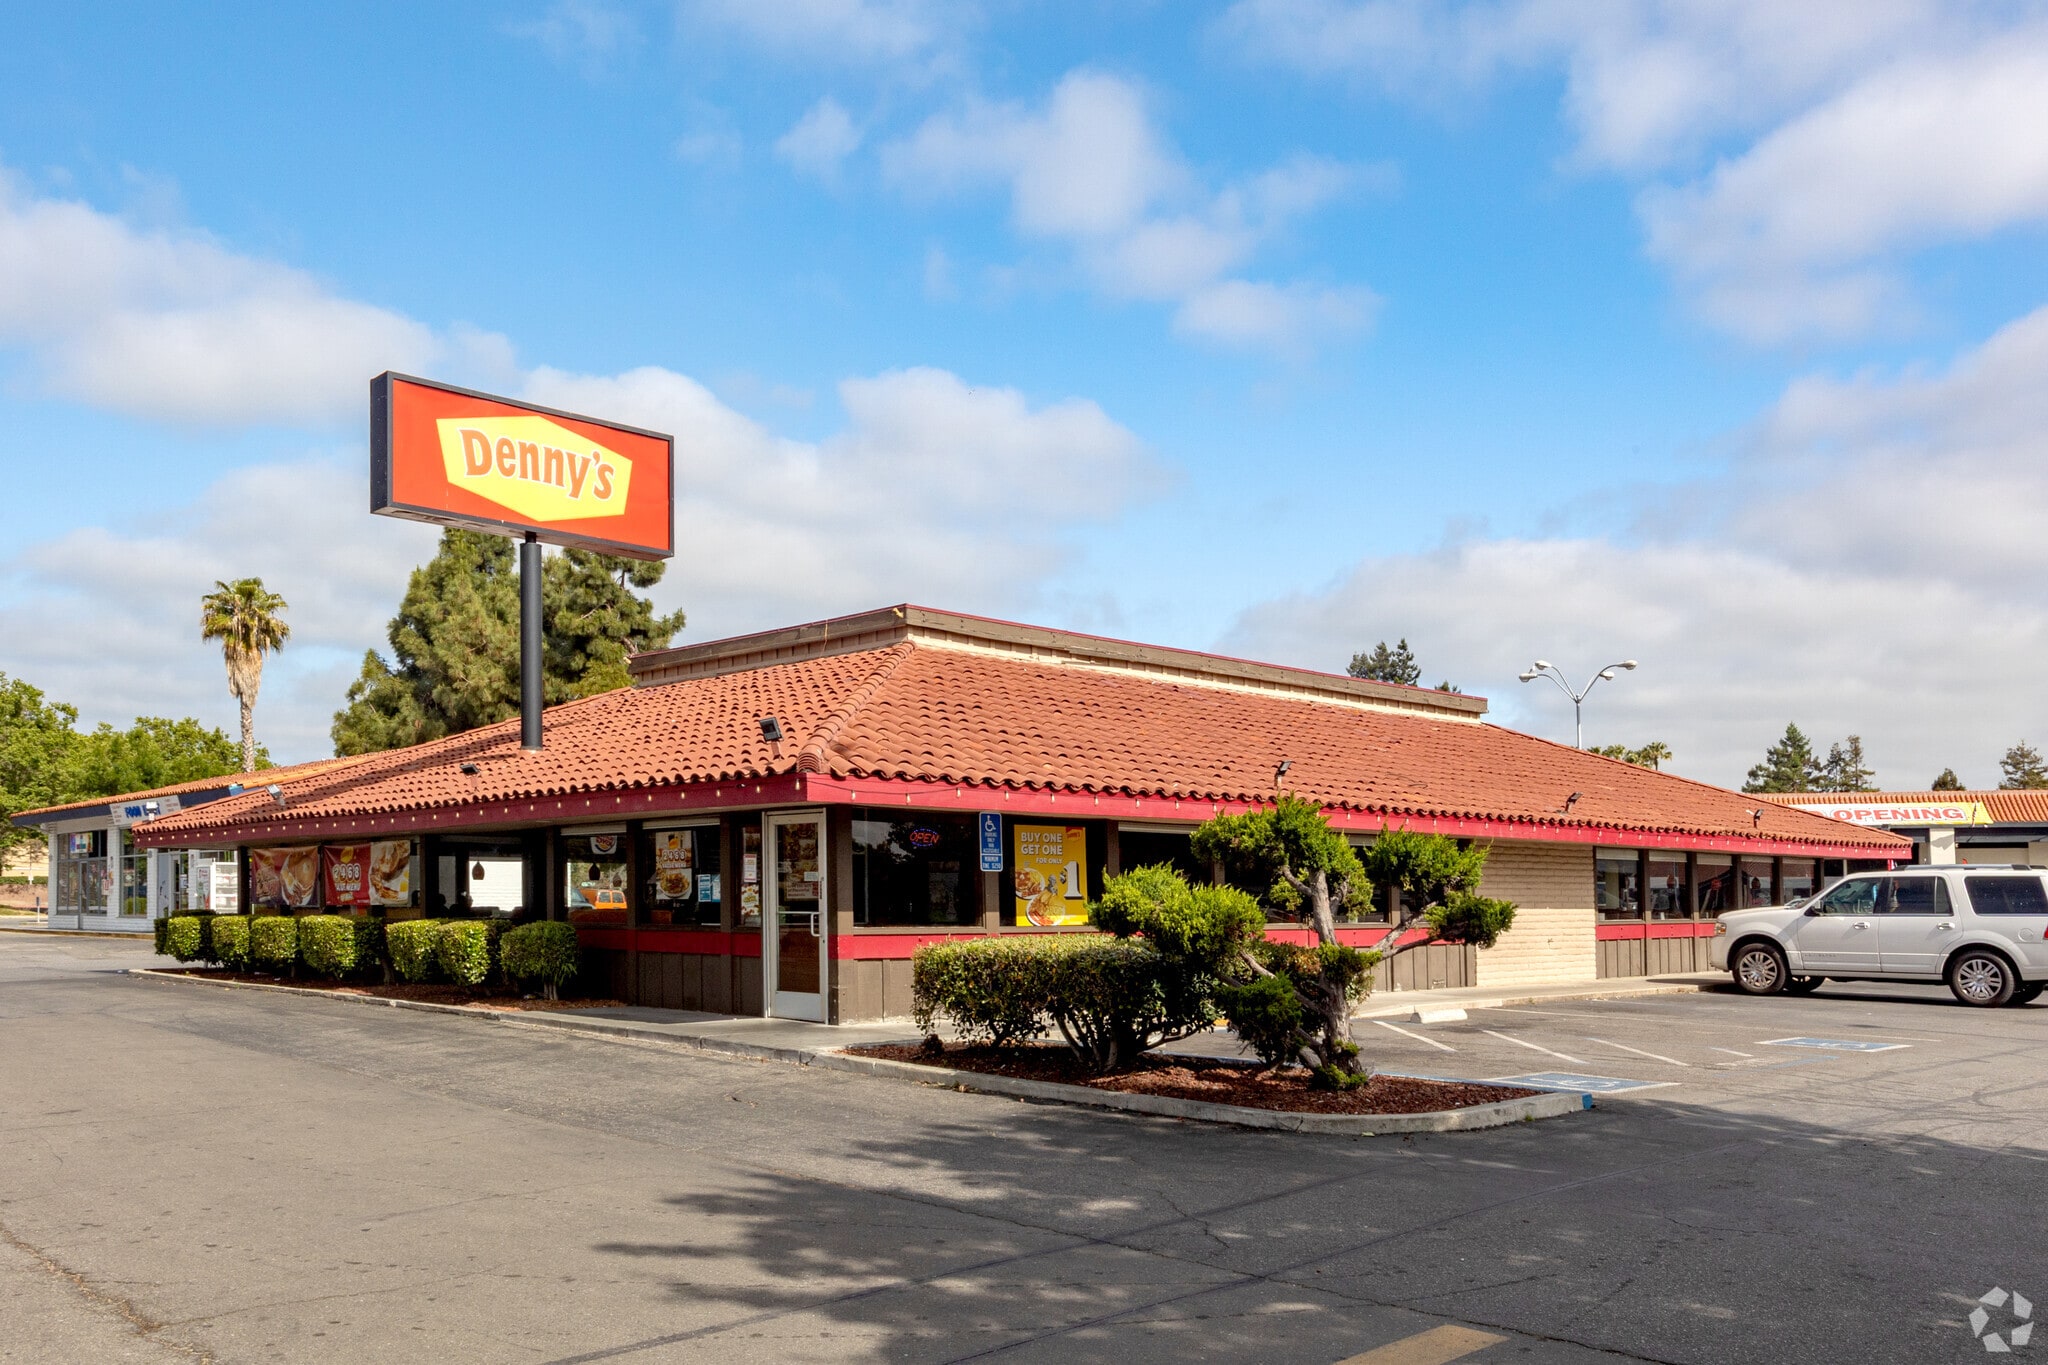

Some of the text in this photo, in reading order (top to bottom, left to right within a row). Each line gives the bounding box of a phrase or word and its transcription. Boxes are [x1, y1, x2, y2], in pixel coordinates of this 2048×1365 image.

[458, 428, 615, 500] Denny's
[1833, 808, 1964, 821] OPENING
[910, 832, 940, 844] OPEN
[1021, 832, 1041, 842] BUY
[1043, 833, 1063, 843] ONE
[1021, 844, 1063, 855] GET ONE
